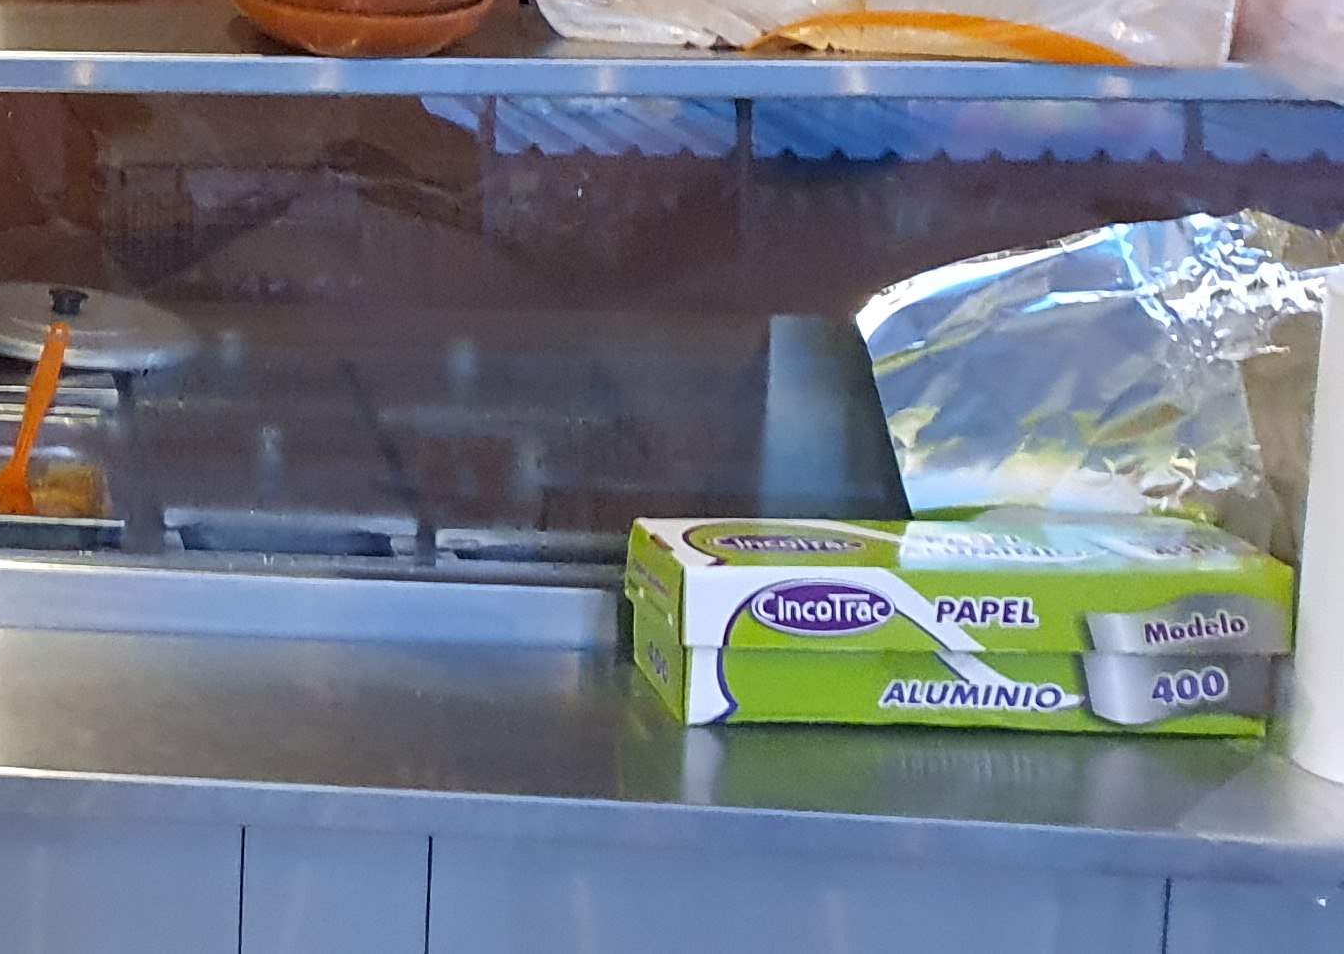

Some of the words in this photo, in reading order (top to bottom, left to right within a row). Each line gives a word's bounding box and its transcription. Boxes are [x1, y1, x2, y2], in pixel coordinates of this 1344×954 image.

[935, 599, 1036, 624] PAPEL
[1144, 612, 1246, 644] Modelo
[882, 681, 1062, 709] ALUMINIO
[1151, 669, 1226, 704] 400
